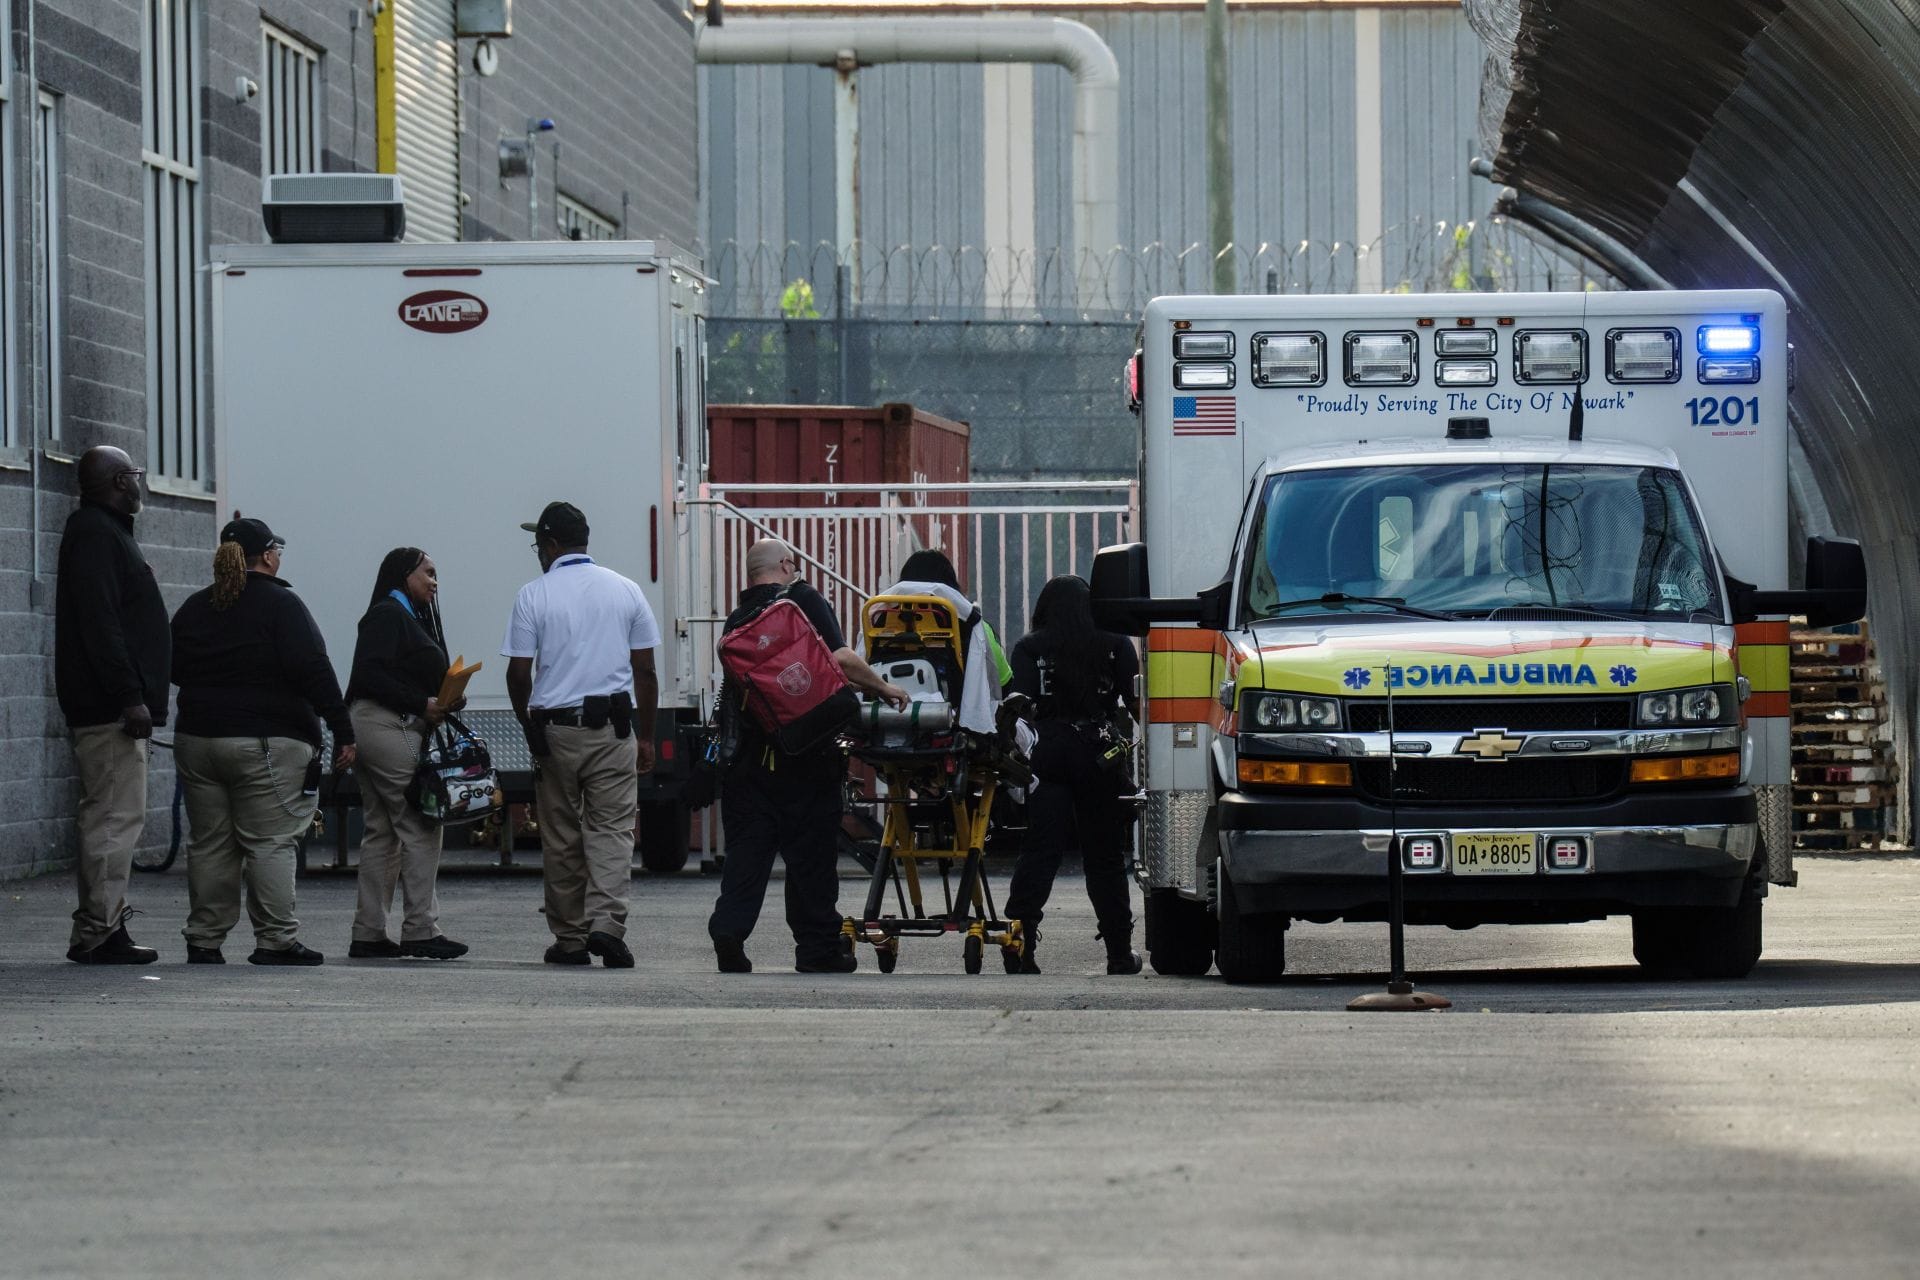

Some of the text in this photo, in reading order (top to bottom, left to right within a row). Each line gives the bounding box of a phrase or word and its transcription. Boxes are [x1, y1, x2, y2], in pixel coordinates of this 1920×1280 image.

[404, 304, 461, 322] LANG
[1377, 394, 1439, 415] Serving
[1446, 392, 1478, 411] The
[1486, 392, 1522, 414] City
[1530, 391, 1554, 412] Of
[1562, 391, 1634, 411] Nwark”
[1684, 395, 1759, 427] 1201
[1473, 834, 1516, 844] New Jersey
[1490, 844, 1531, 865] 8805
